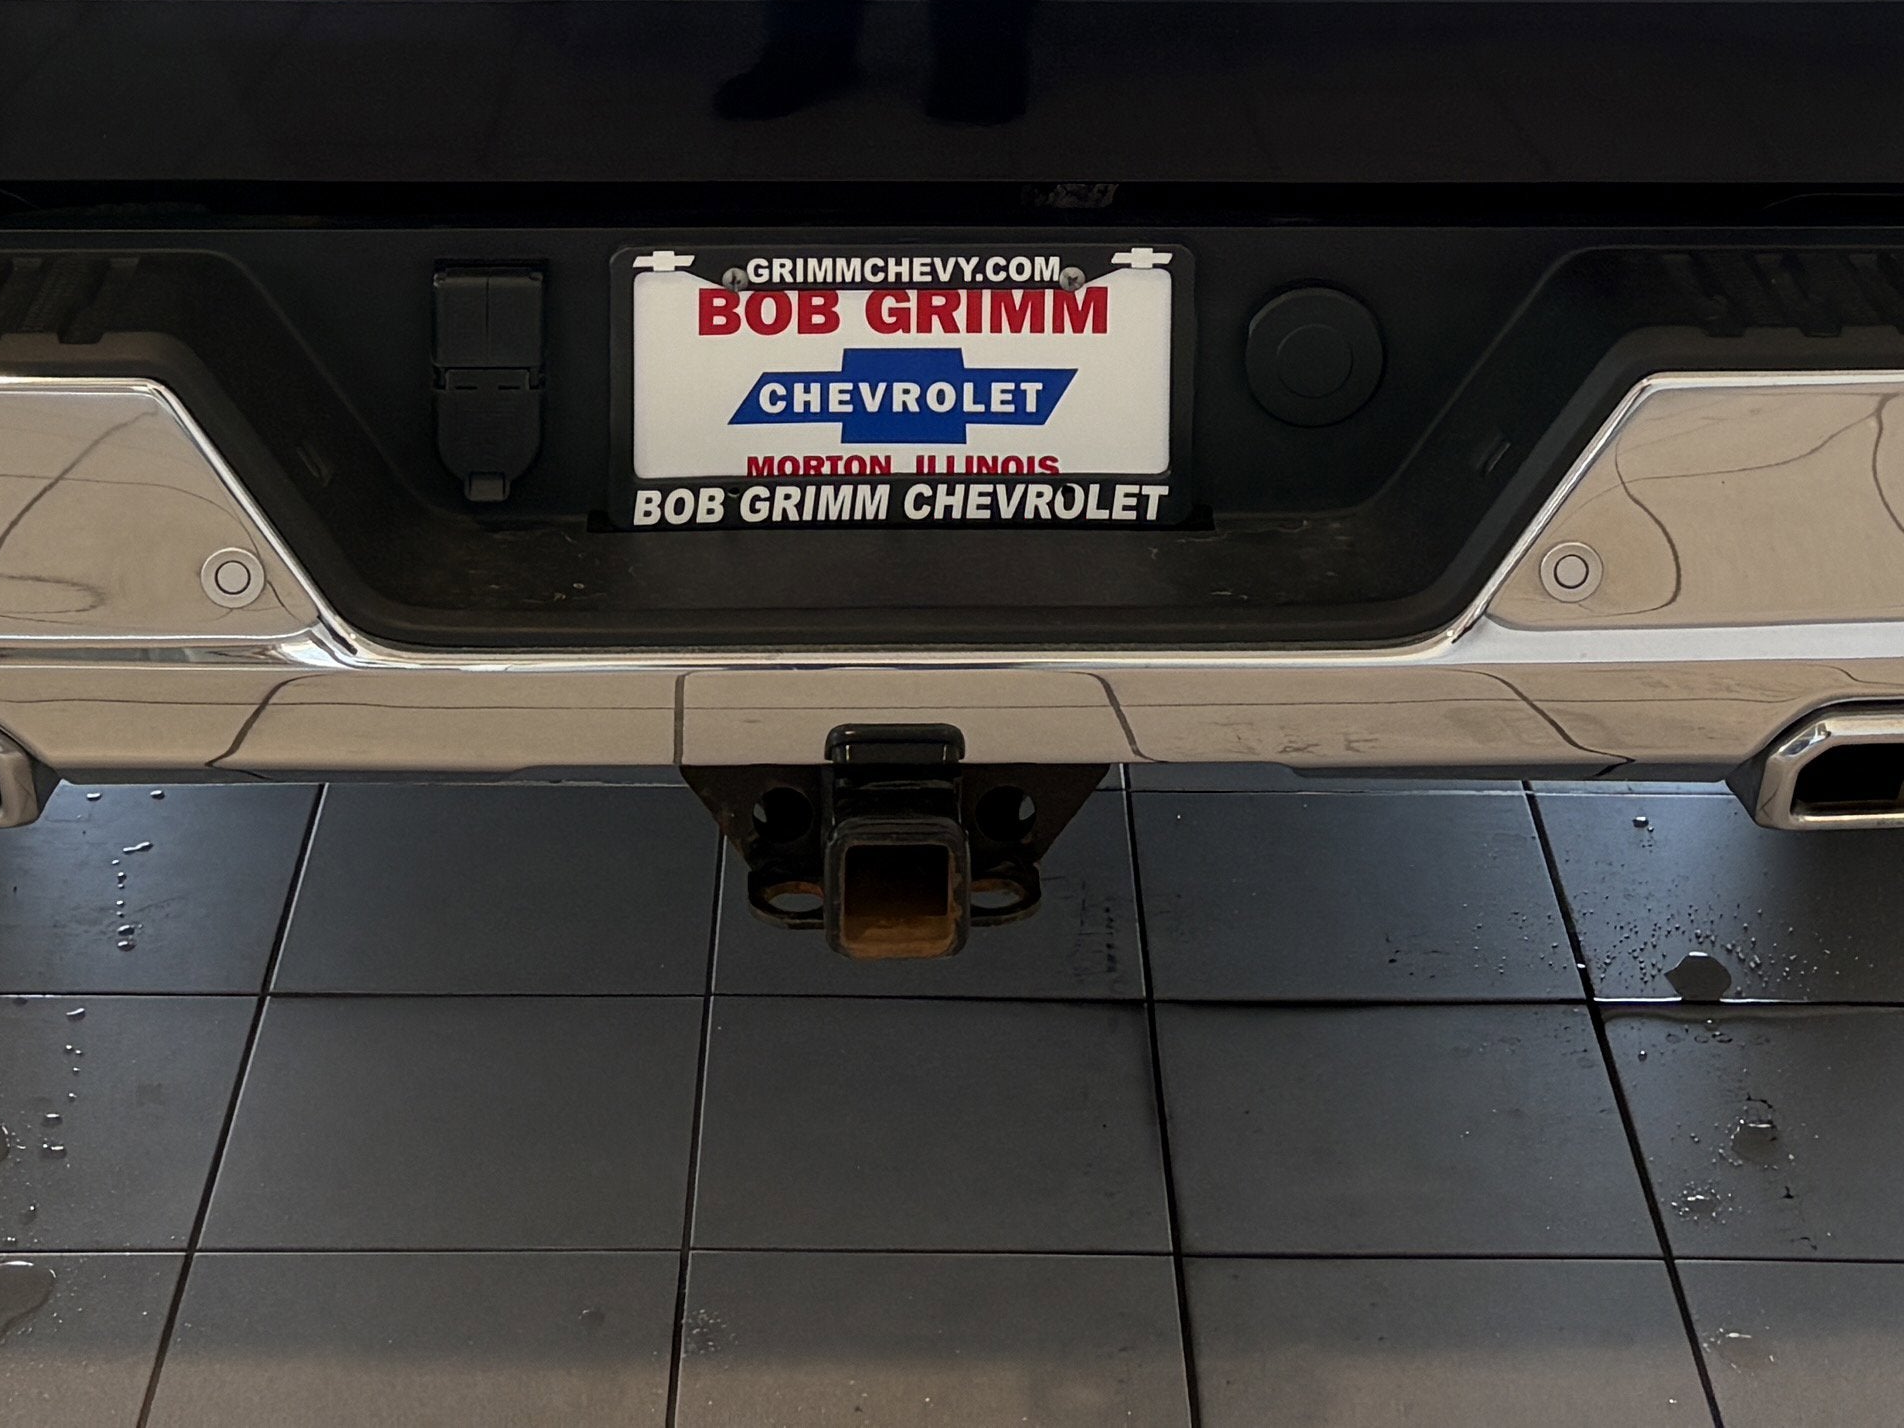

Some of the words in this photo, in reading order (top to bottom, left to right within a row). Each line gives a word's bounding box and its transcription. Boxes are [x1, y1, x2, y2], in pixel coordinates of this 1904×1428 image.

[747, 256, 1061, 285] GRIMMCHEVY.COM
[698, 289, 841, 336] BOB
[865, 287, 1109, 335] GRIMM
[758, 380, 1044, 414] CHEVROLET
[747, 454, 892, 477] MORTON
[633, 488, 725, 526] BOB
[739, 483, 891, 522] GRIMM
[903, 482, 1170, 521] CHEVROLET
